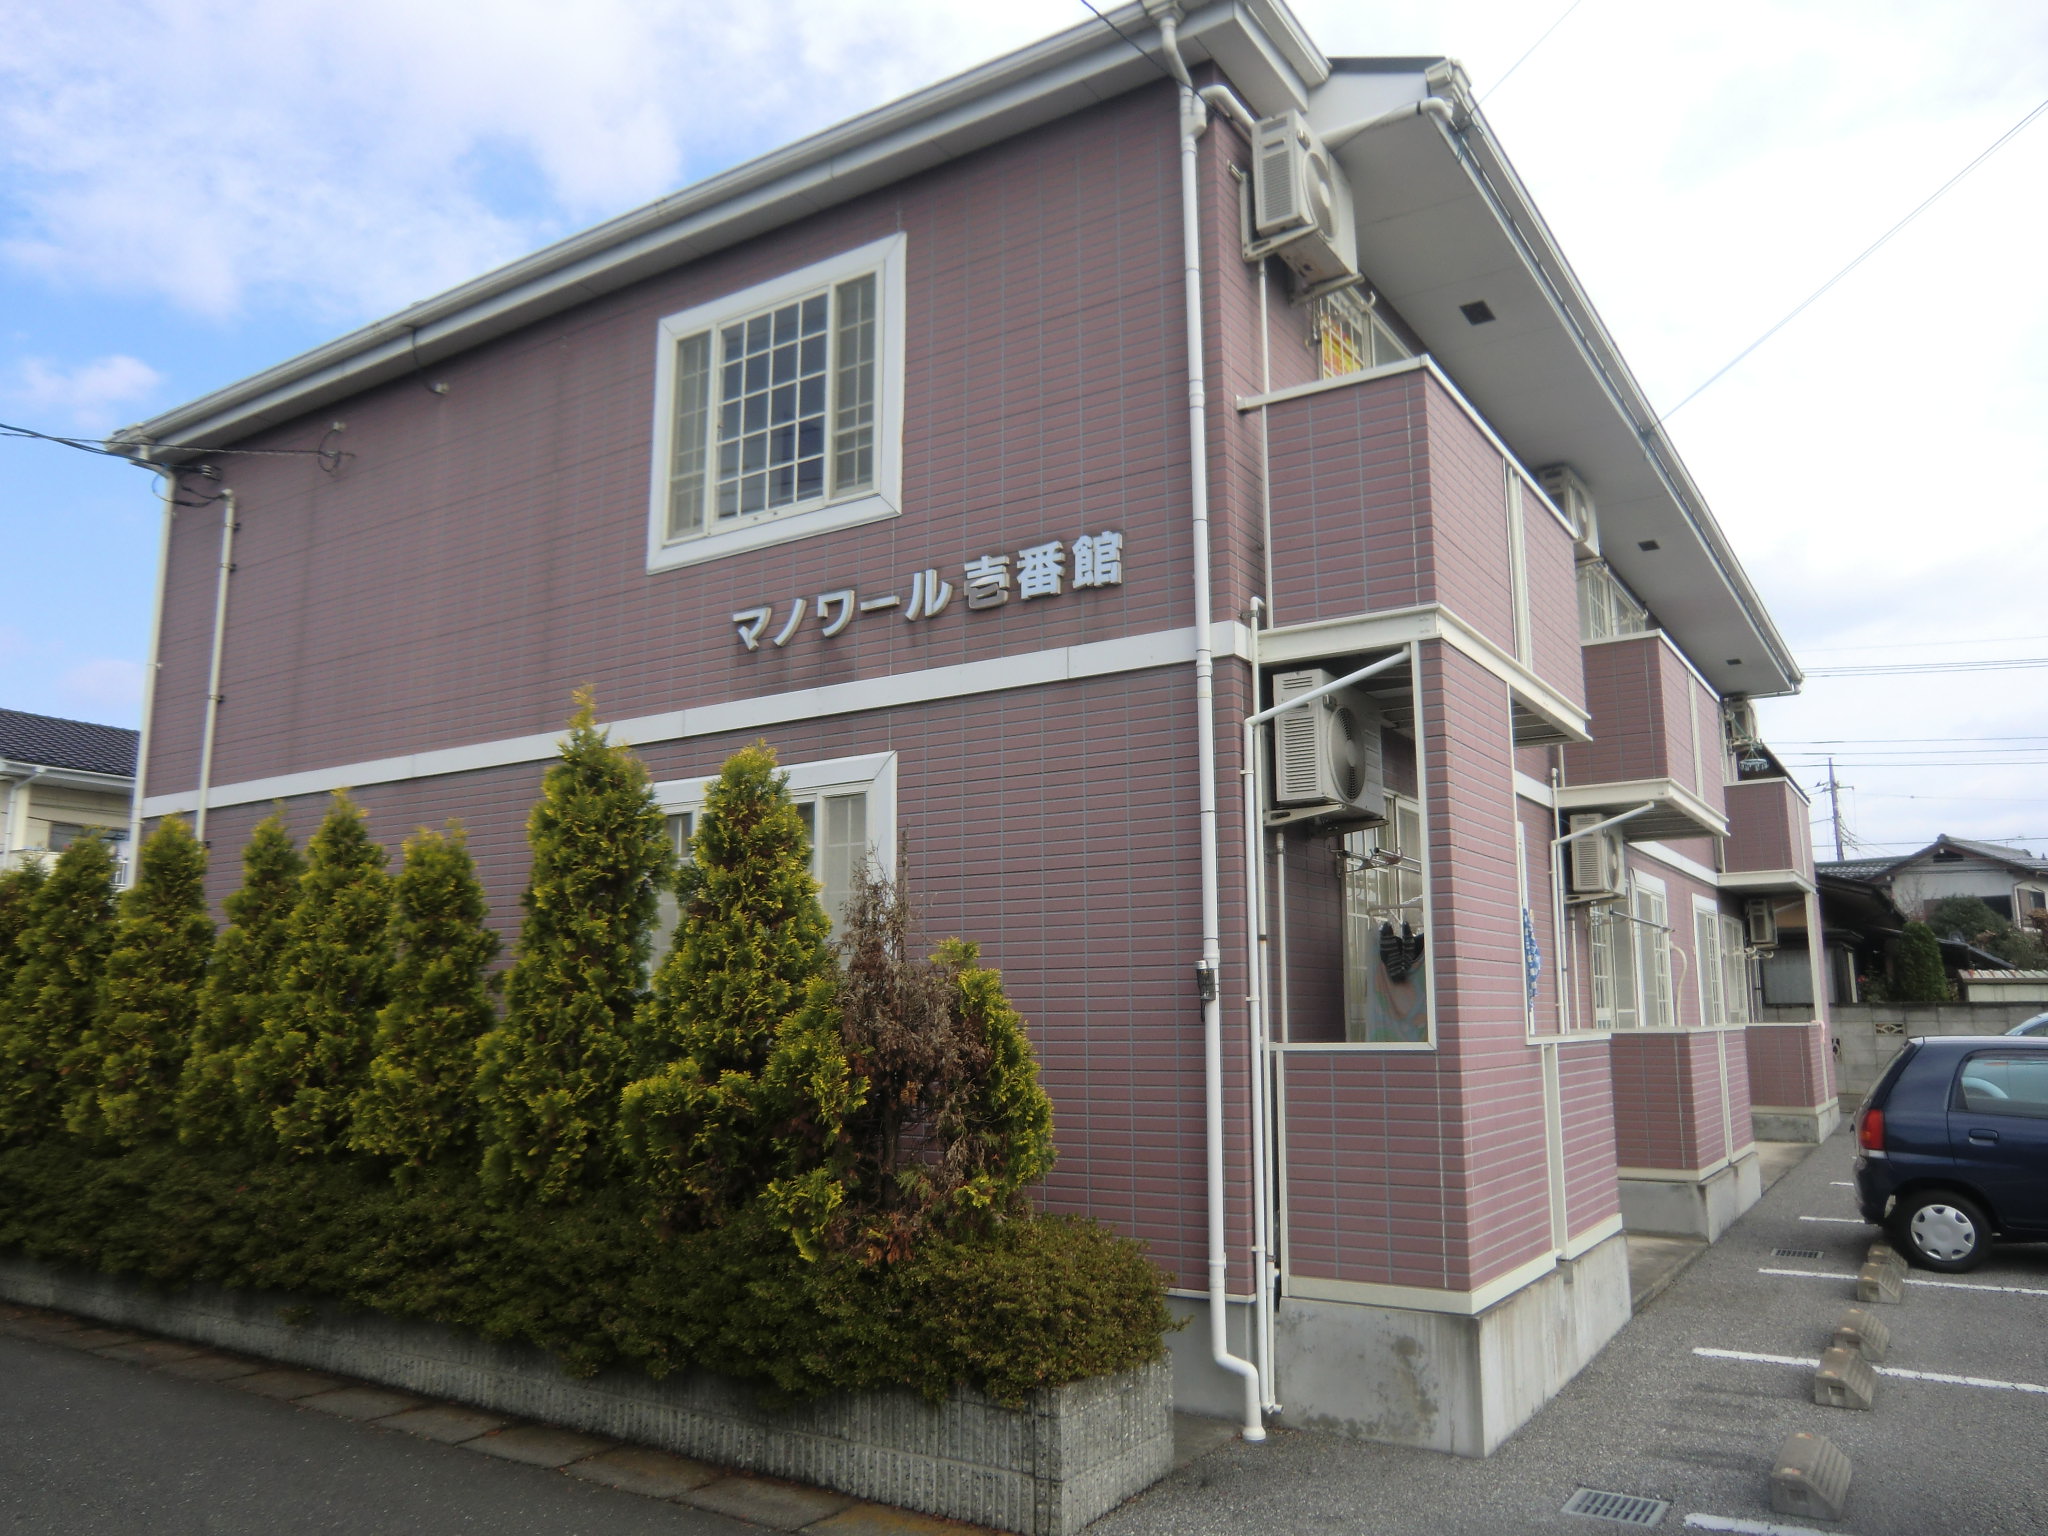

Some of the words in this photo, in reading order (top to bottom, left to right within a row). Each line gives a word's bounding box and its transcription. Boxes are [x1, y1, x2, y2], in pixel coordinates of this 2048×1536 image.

[732, 530, 1123, 651] マノワール壱番館
